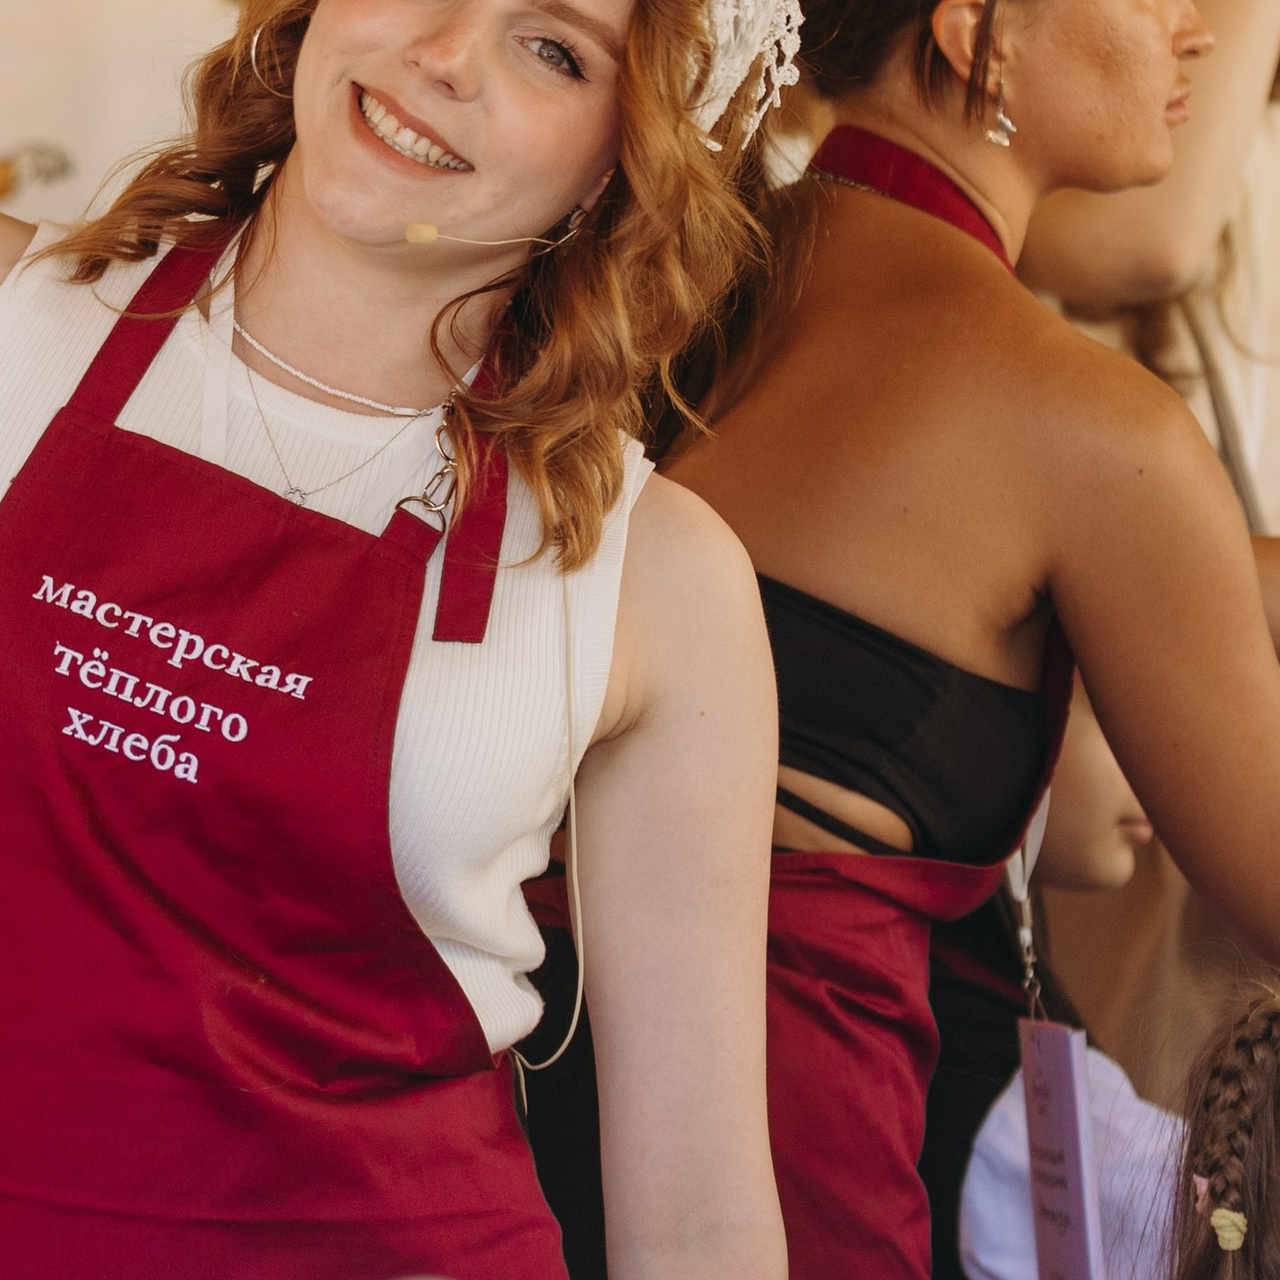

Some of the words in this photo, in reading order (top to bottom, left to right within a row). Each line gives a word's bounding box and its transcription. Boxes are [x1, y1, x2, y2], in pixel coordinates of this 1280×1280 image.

[32, 574, 314, 700] мастерская
[53, 641, 249, 743] тёплого
[61, 706, 199, 784] хлеба
